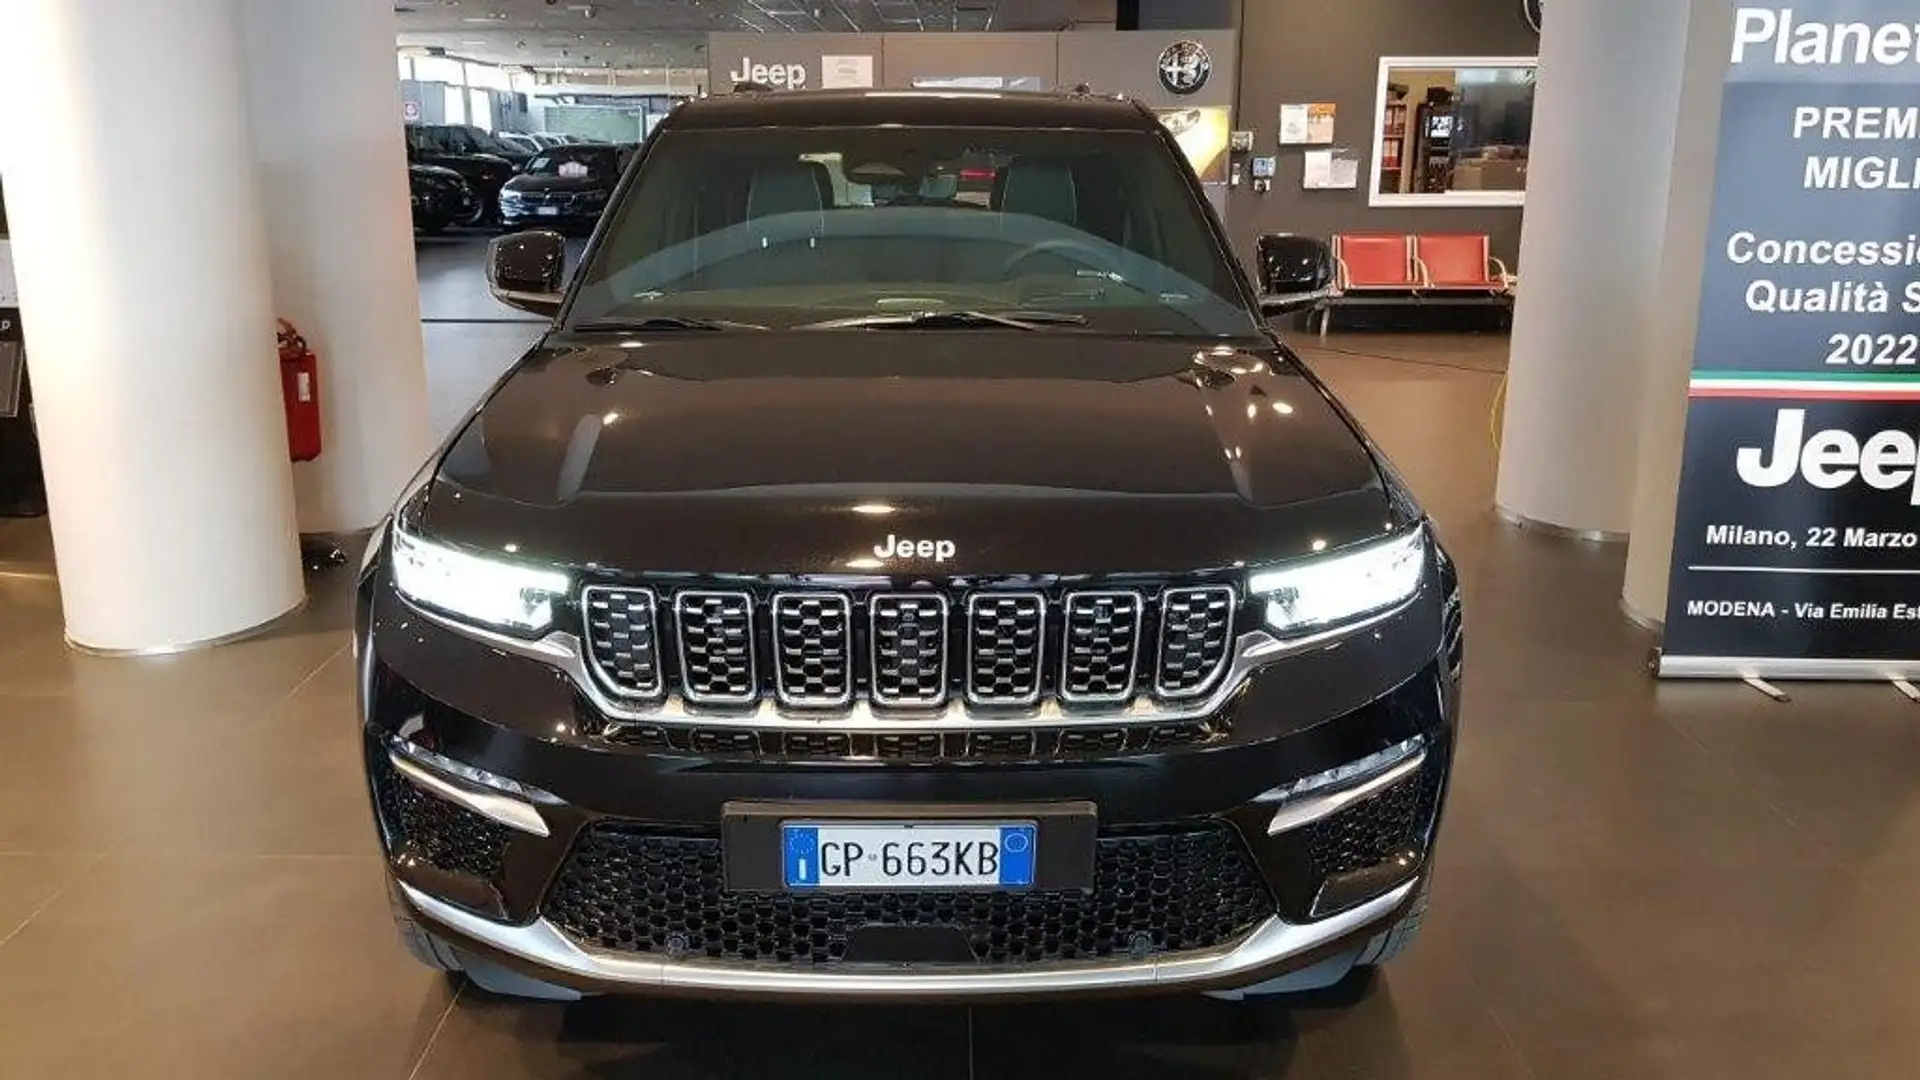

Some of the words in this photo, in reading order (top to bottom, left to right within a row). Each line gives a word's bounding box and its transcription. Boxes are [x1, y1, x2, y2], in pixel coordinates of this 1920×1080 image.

[1730, 8, 1920, 65] Plane
[730, 57, 806, 90] Jeep
[1793, 106, 1920, 139] PREM
[1727, 232, 1920, 266] Concessi
[1745, 279, 1888, 313] Qualità
[1825, 333, 1918, 365] 2022
[1736, 408, 1920, 506] Jee
[873, 534, 956, 562] Jeep
[1706, 524, 1797, 550] Milano,
[1805, 527, 1837, 547] 22
[1843, 527, 1918, 547] Marzo
[1687, 600, 1775, 618] MODENA
[1794, 602, 1824, 619] Via
[1830, 603, 1887, 619] Emilia
[821, 842, 863, 877] GP
[882, 842, 998, 877] 663KB
